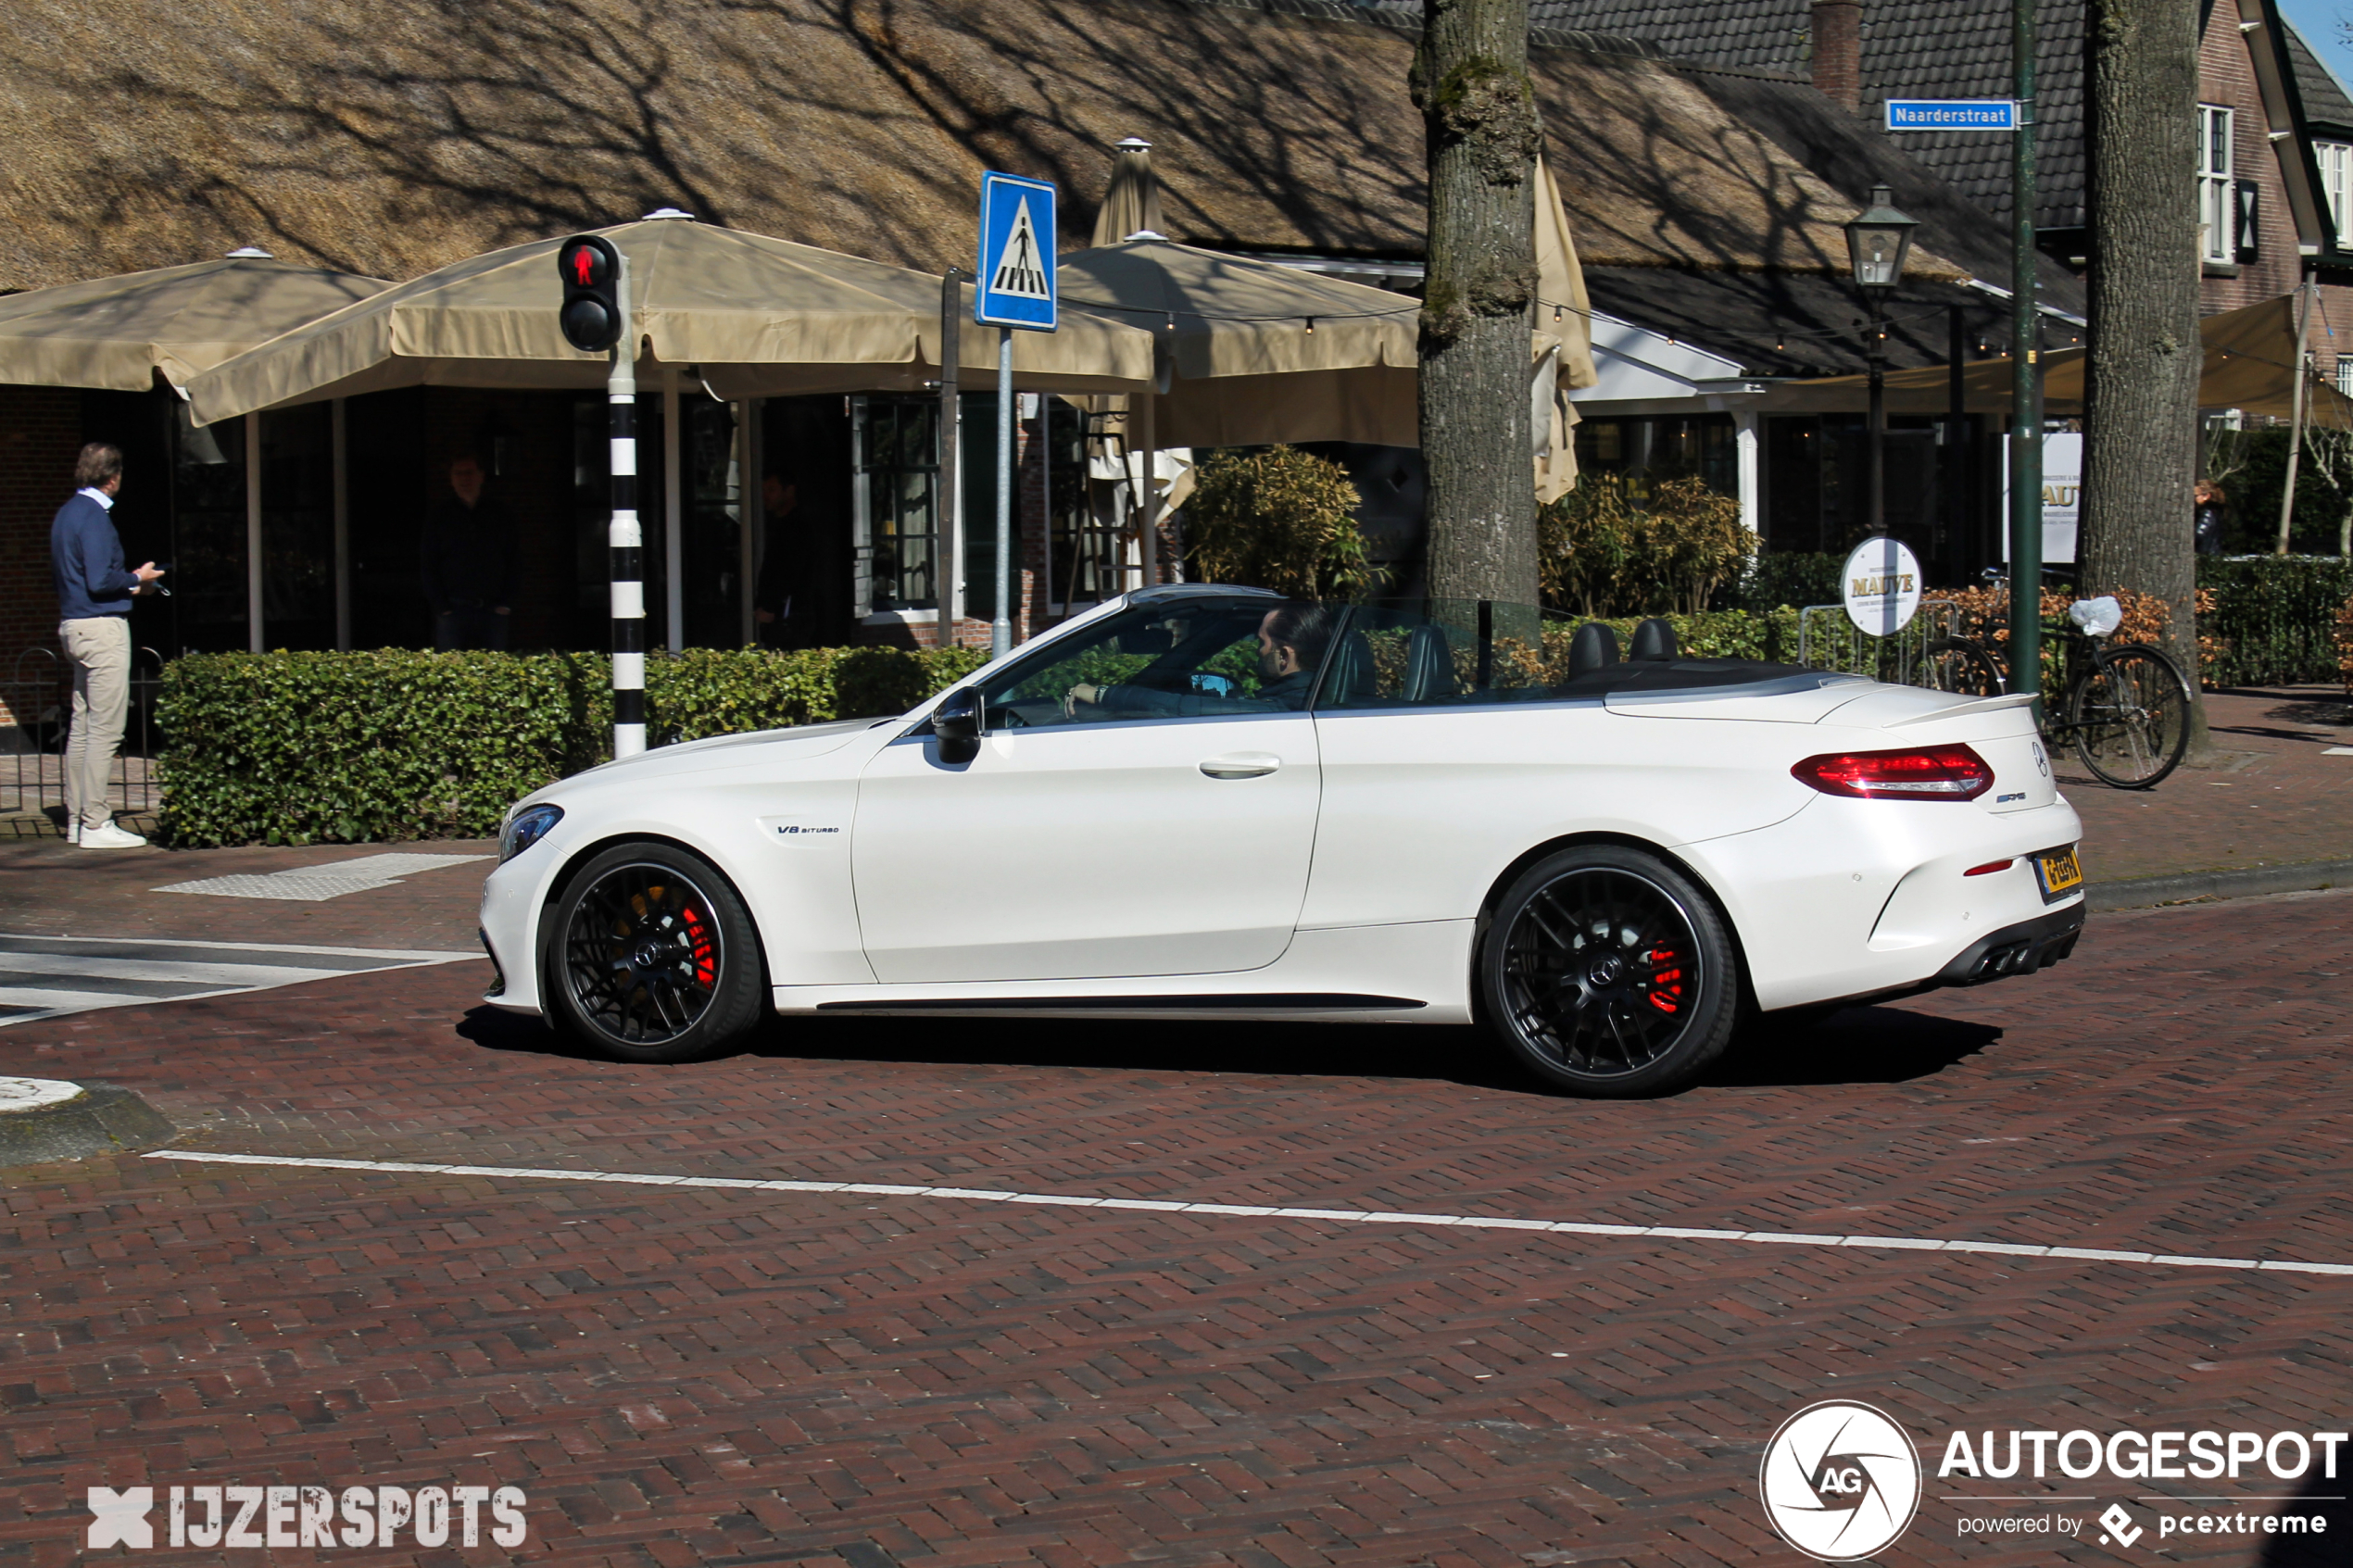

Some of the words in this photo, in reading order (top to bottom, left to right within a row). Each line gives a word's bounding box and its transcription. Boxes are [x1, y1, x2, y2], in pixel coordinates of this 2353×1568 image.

[1895, 107, 2006, 123] Naarderstraat
[2042, 485, 2081, 508] AU
[1851, 573, 1914, 598] MAUVE
